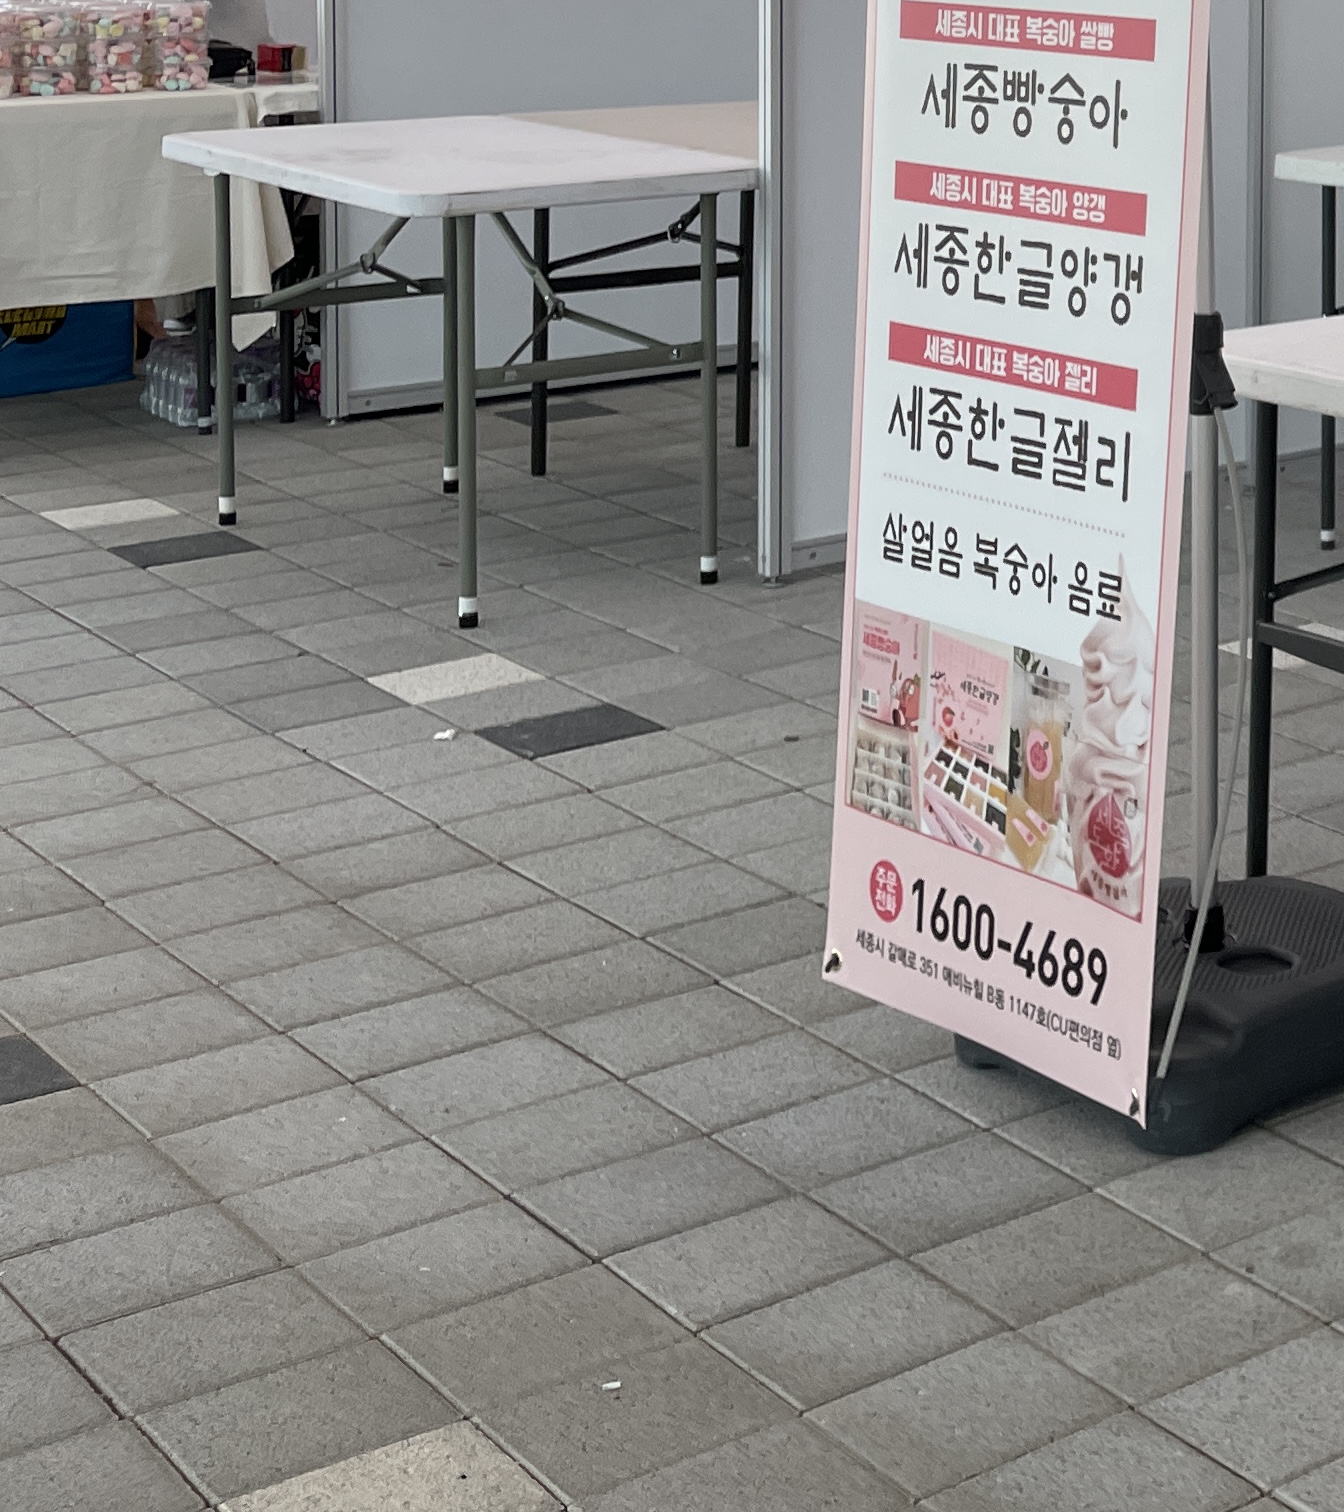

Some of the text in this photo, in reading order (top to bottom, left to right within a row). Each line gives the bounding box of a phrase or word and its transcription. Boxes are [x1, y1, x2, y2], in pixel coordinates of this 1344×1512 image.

[935, 9, 1114, 51] 세종시 대표 복숭아 쌀빵
[921, 62, 1128, 149] 세종빵숭아
[930, 172, 1106, 223] 세종시 대표 복숭아 양갱
[894, 223, 1143, 325] 세종한글양갱
[923, 333, 1097, 396] 세종시 대표 복숭아 젤리
[888, 386, 1130, 502] 세종한글젤리
[883, 513, 1122, 622] 살얼음 복숭아 음료
[856, 929, 885, 958] 세종시
[920, 956, 938, 979] 351
[912, 878, 1108, 1006] 1600-4689
